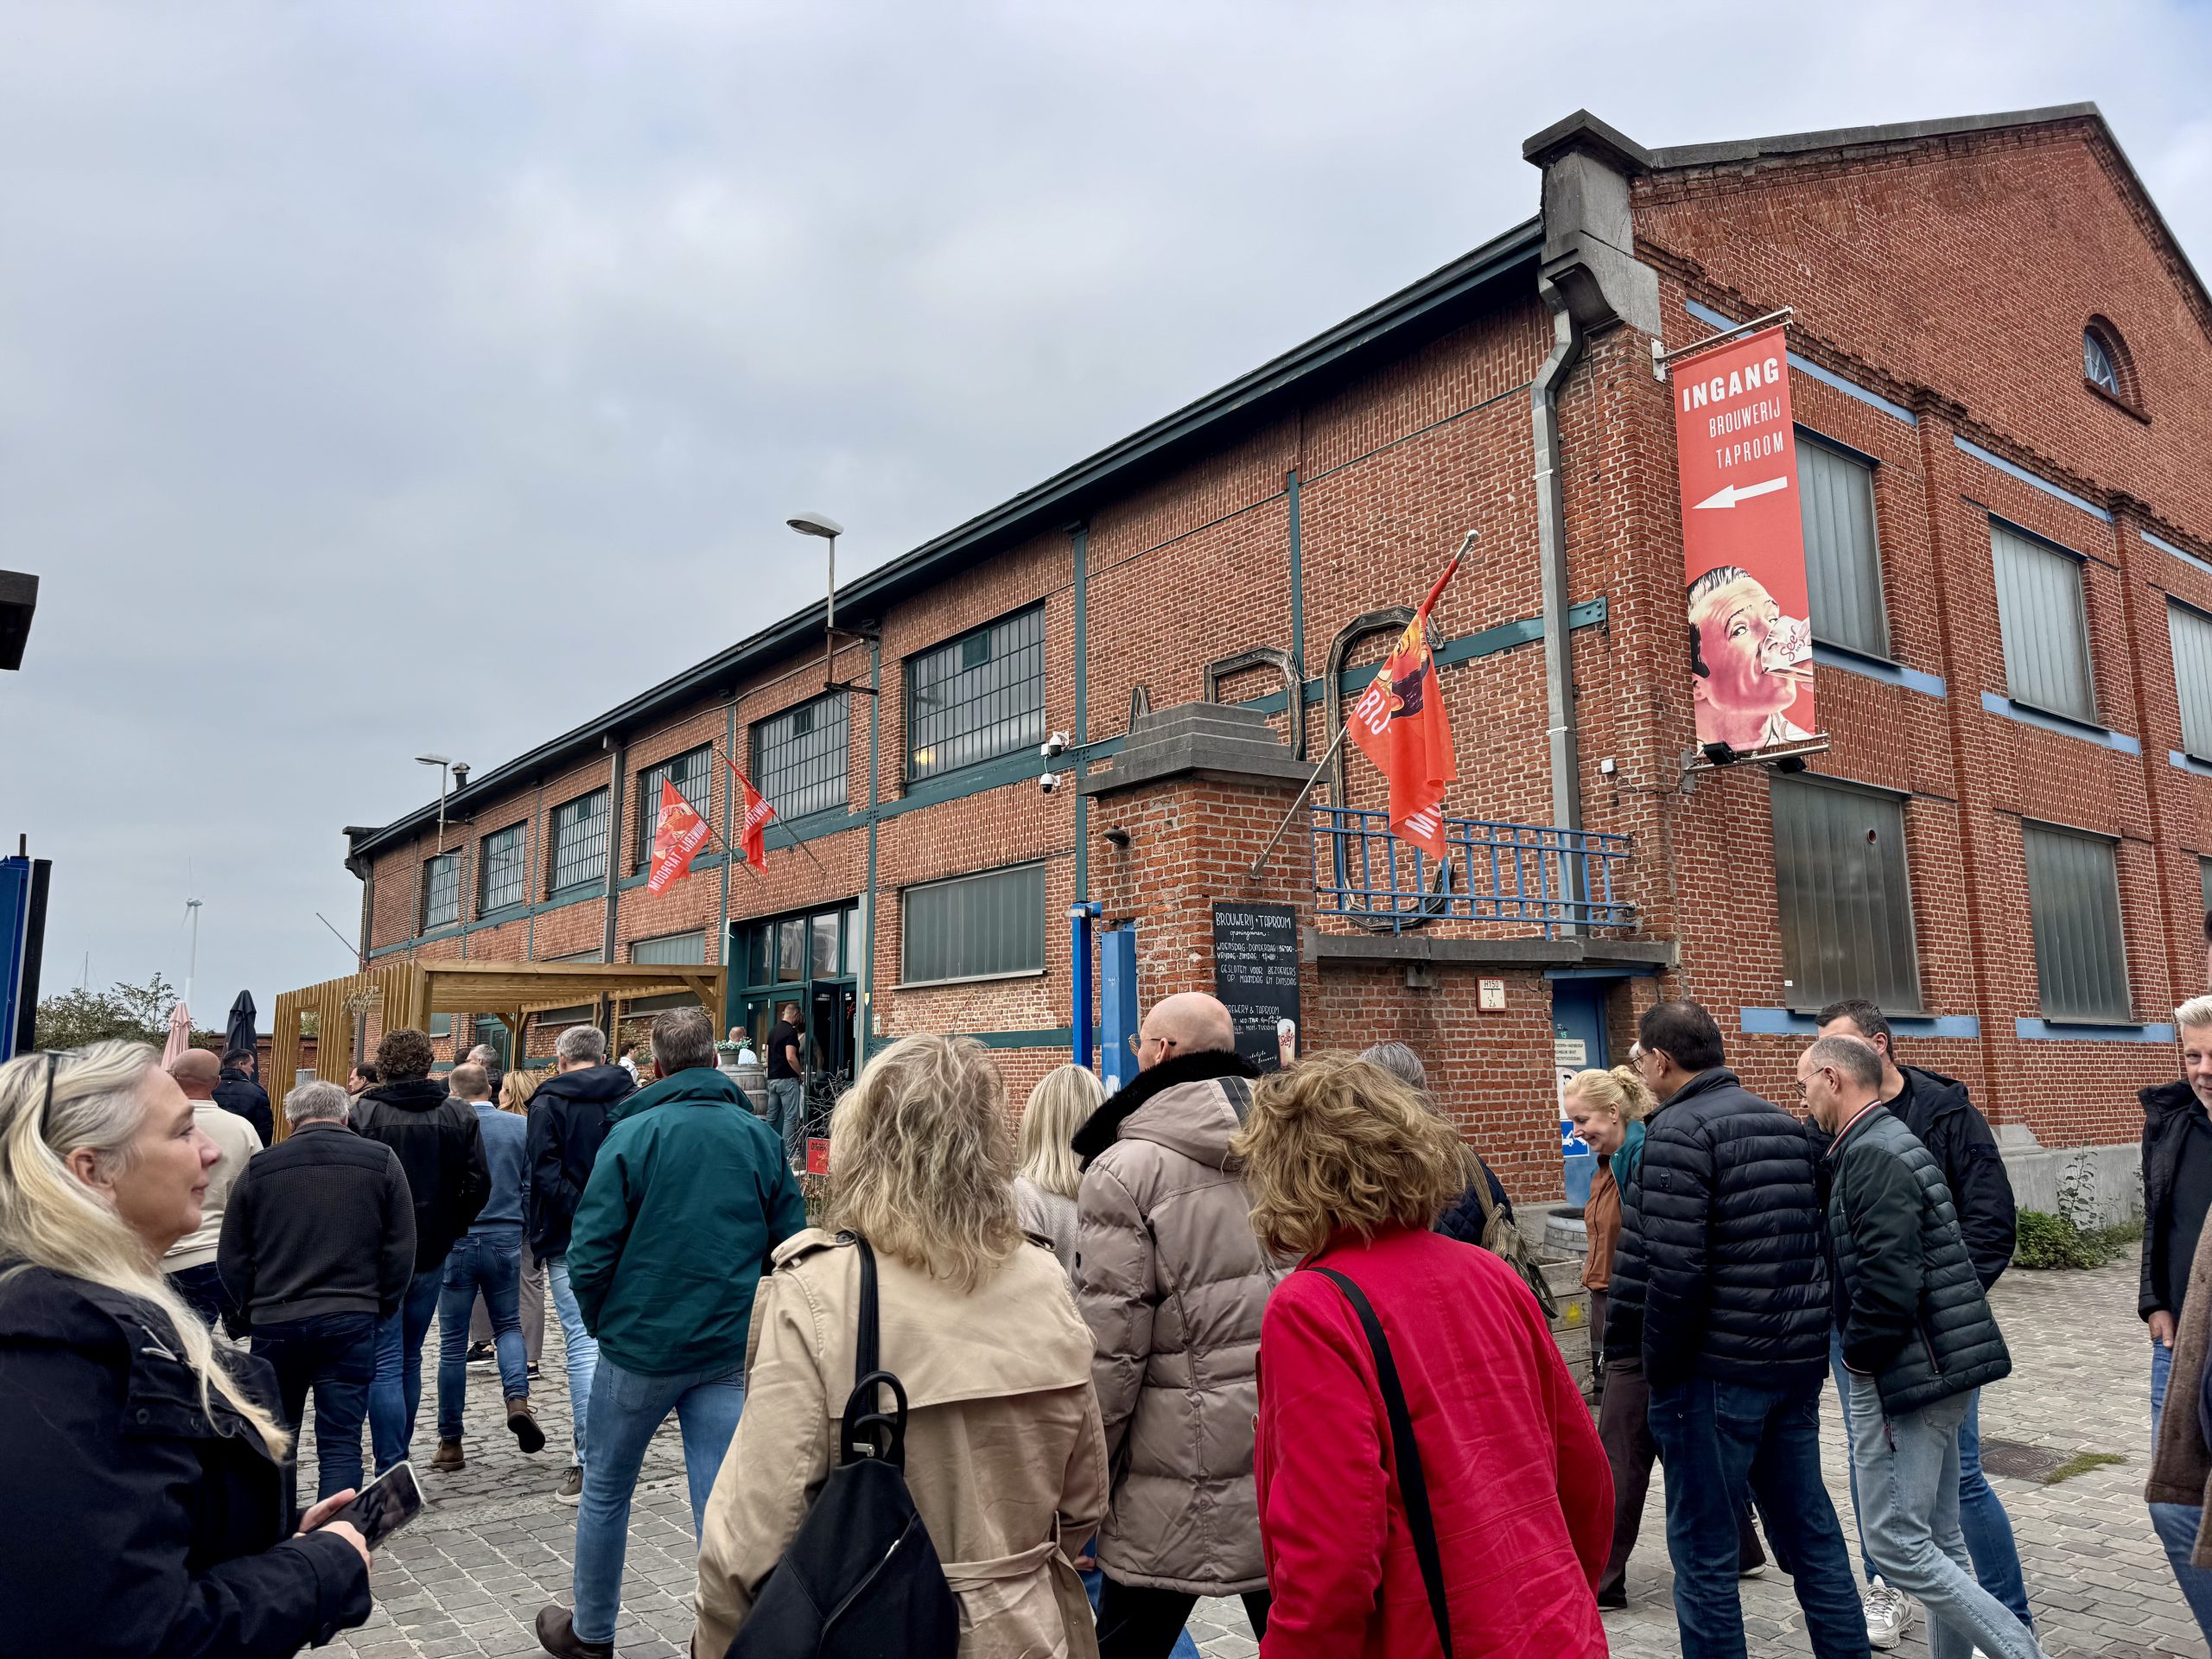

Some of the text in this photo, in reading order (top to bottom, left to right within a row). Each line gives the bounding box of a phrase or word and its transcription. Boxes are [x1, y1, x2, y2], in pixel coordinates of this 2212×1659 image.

[1682, 357, 1780, 412] INGANG
[1708, 396, 1782, 438] BROUWERIJ
[1715, 430, 1784, 469] TAPROOM
[1215, 912, 1255, 931] BROUWERIJ
[1257, 914, 1292, 930] TAPROOM
[1220, 963, 1247, 975] GESLOTEN
[1249, 966, 1262, 975] VOOR
[1227, 974, 1235, 982] OP
[1239, 975, 1262, 984] MAANDAG
[1276, 976, 1297, 986] DINSDAG
[1484, 980, 1499, 988] H150
[1255, 1005, 1280, 1015] TAPROOM
